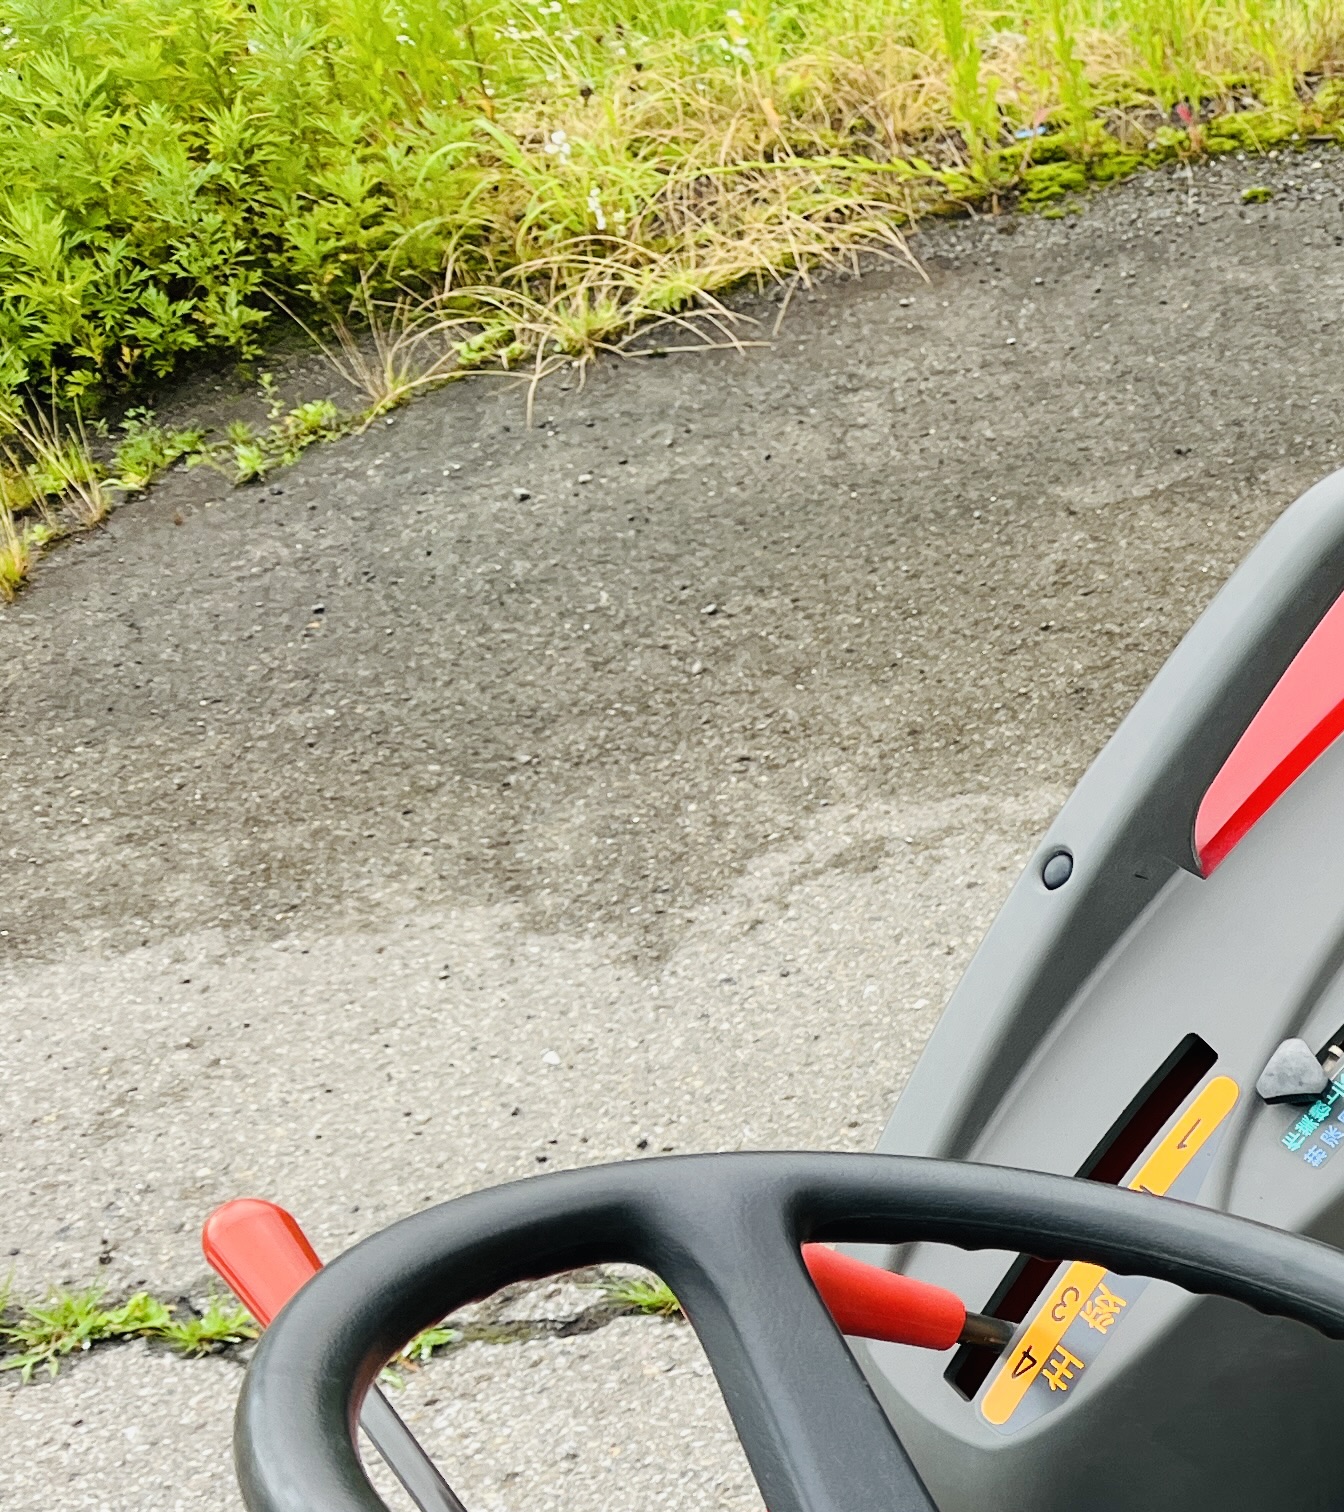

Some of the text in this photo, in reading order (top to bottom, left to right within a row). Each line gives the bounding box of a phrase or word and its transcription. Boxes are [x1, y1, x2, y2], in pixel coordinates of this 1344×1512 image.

[1177, 1117, 1202, 1150] 1
[1050, 1286, 1080, 1322] 3
[1010, 1344, 1038, 1379] 4
